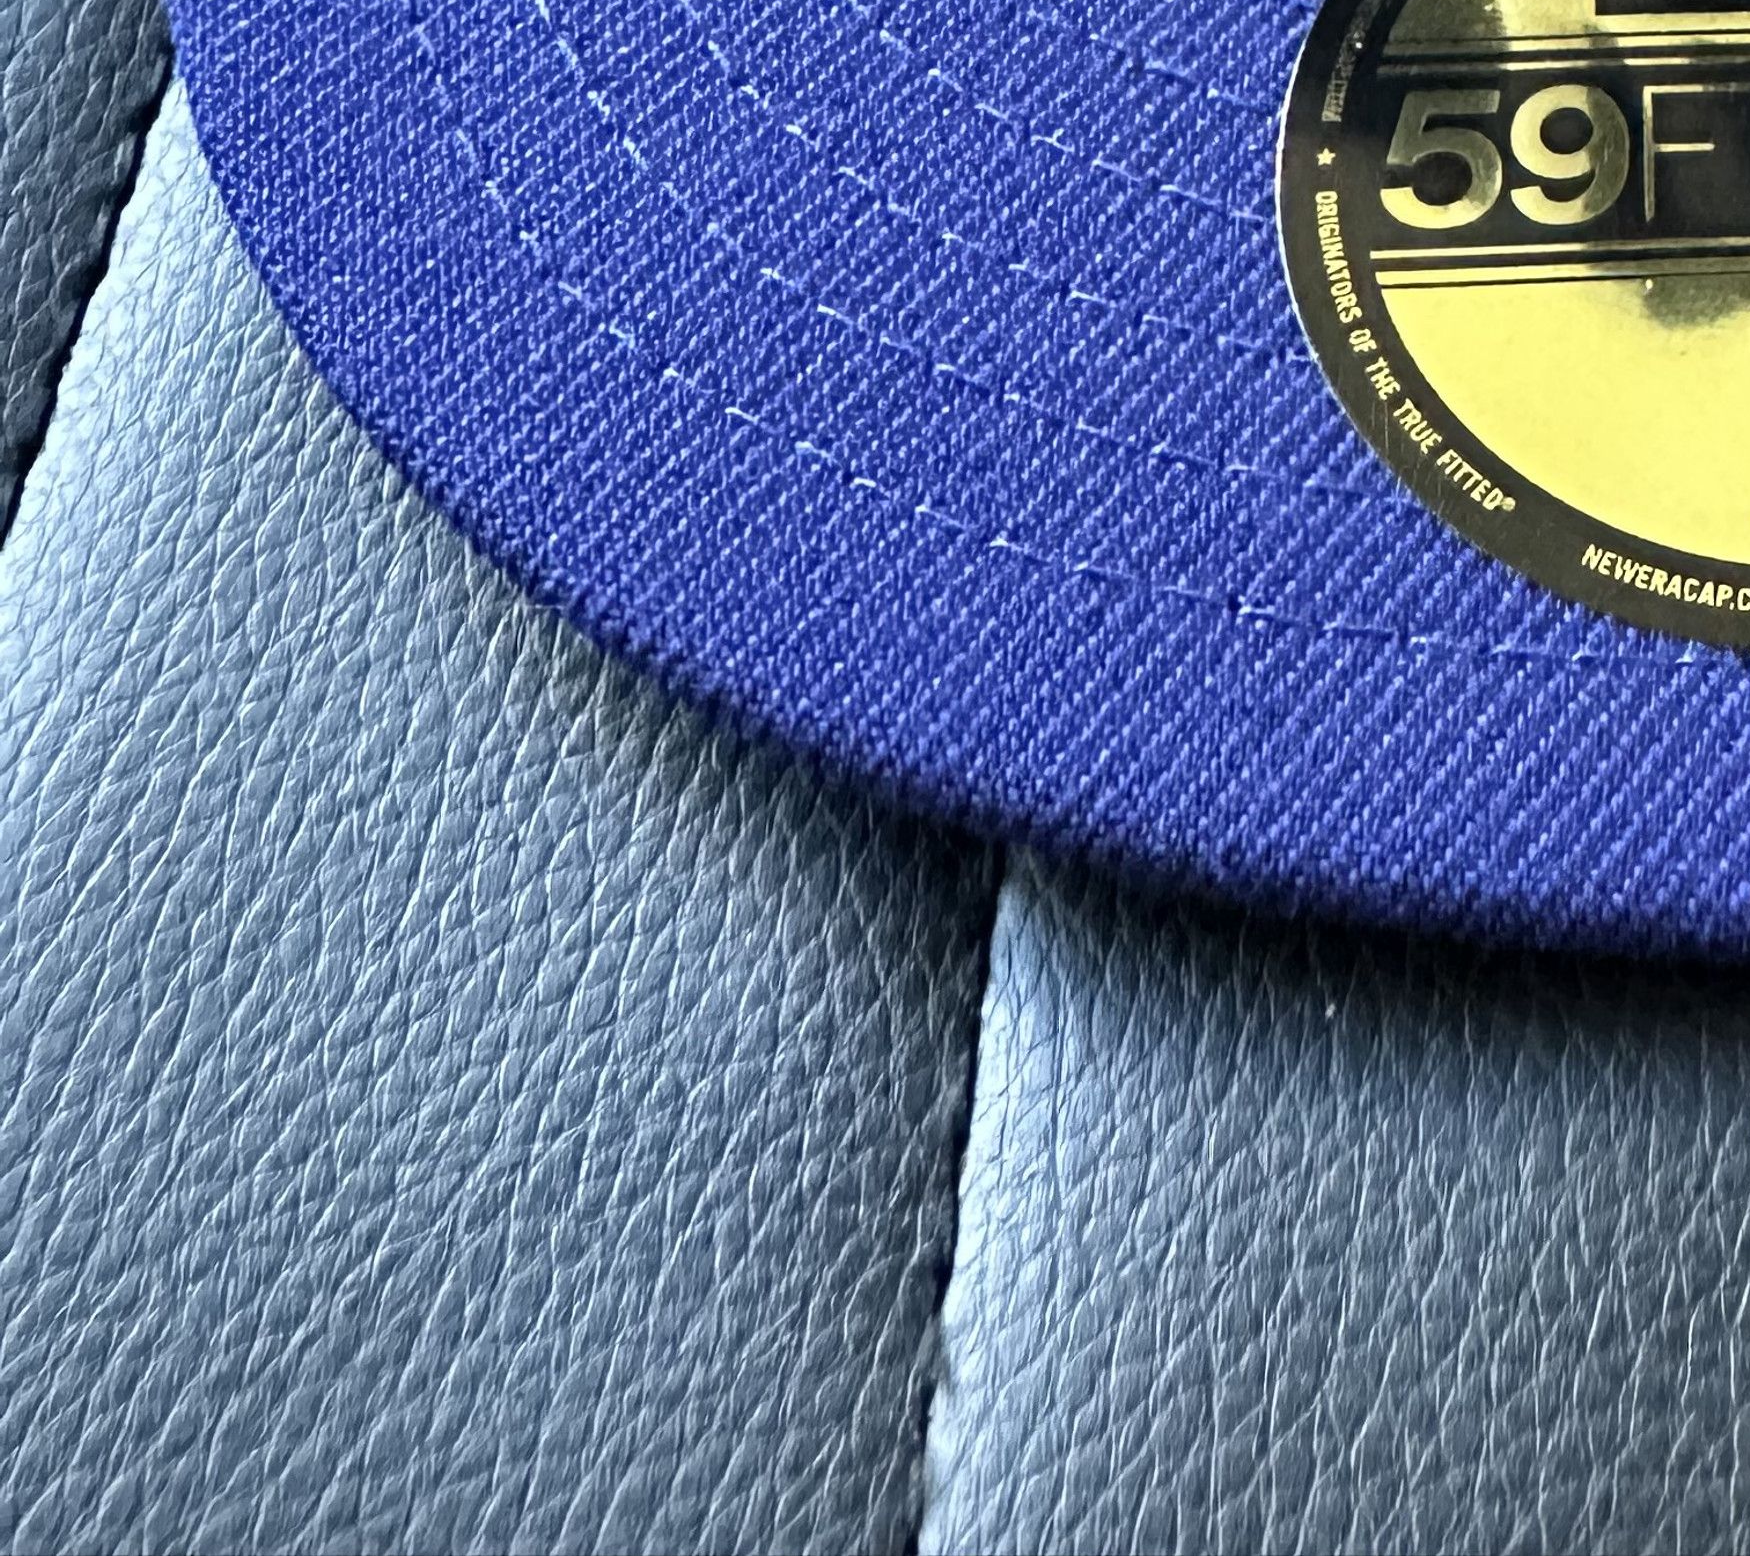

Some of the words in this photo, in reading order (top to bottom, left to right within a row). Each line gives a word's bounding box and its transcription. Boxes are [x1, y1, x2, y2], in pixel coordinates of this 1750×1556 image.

[1314, 190, 1363, 325] ORIGINATORS
[1348, 328, 1377, 355] OF
[1365, 356, 1401, 401] THE
[1392, 397, 1443, 455] TRUE
